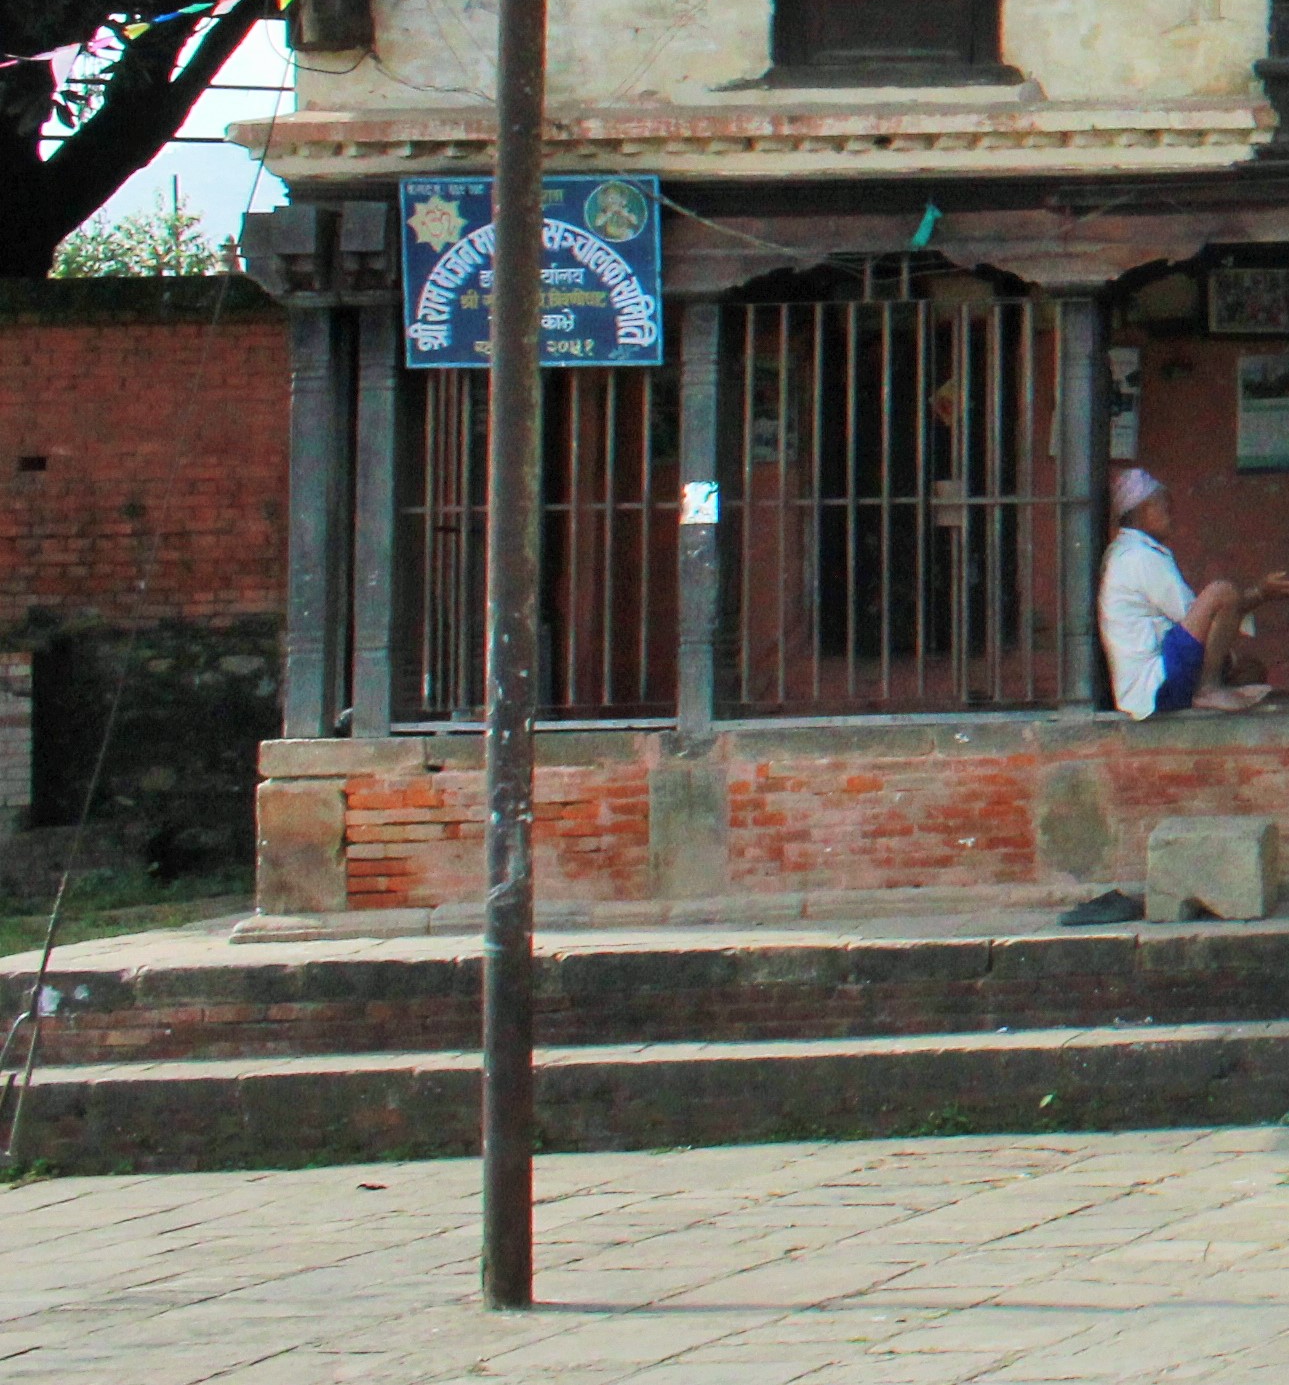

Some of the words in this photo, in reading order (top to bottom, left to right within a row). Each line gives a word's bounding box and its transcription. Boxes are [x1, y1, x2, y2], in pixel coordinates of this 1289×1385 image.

[427, 237, 488, 289] भजन
[416, 280, 456, 322] राम
[610, 279, 658, 349] समिति
[406, 321, 450, 351] श्री
